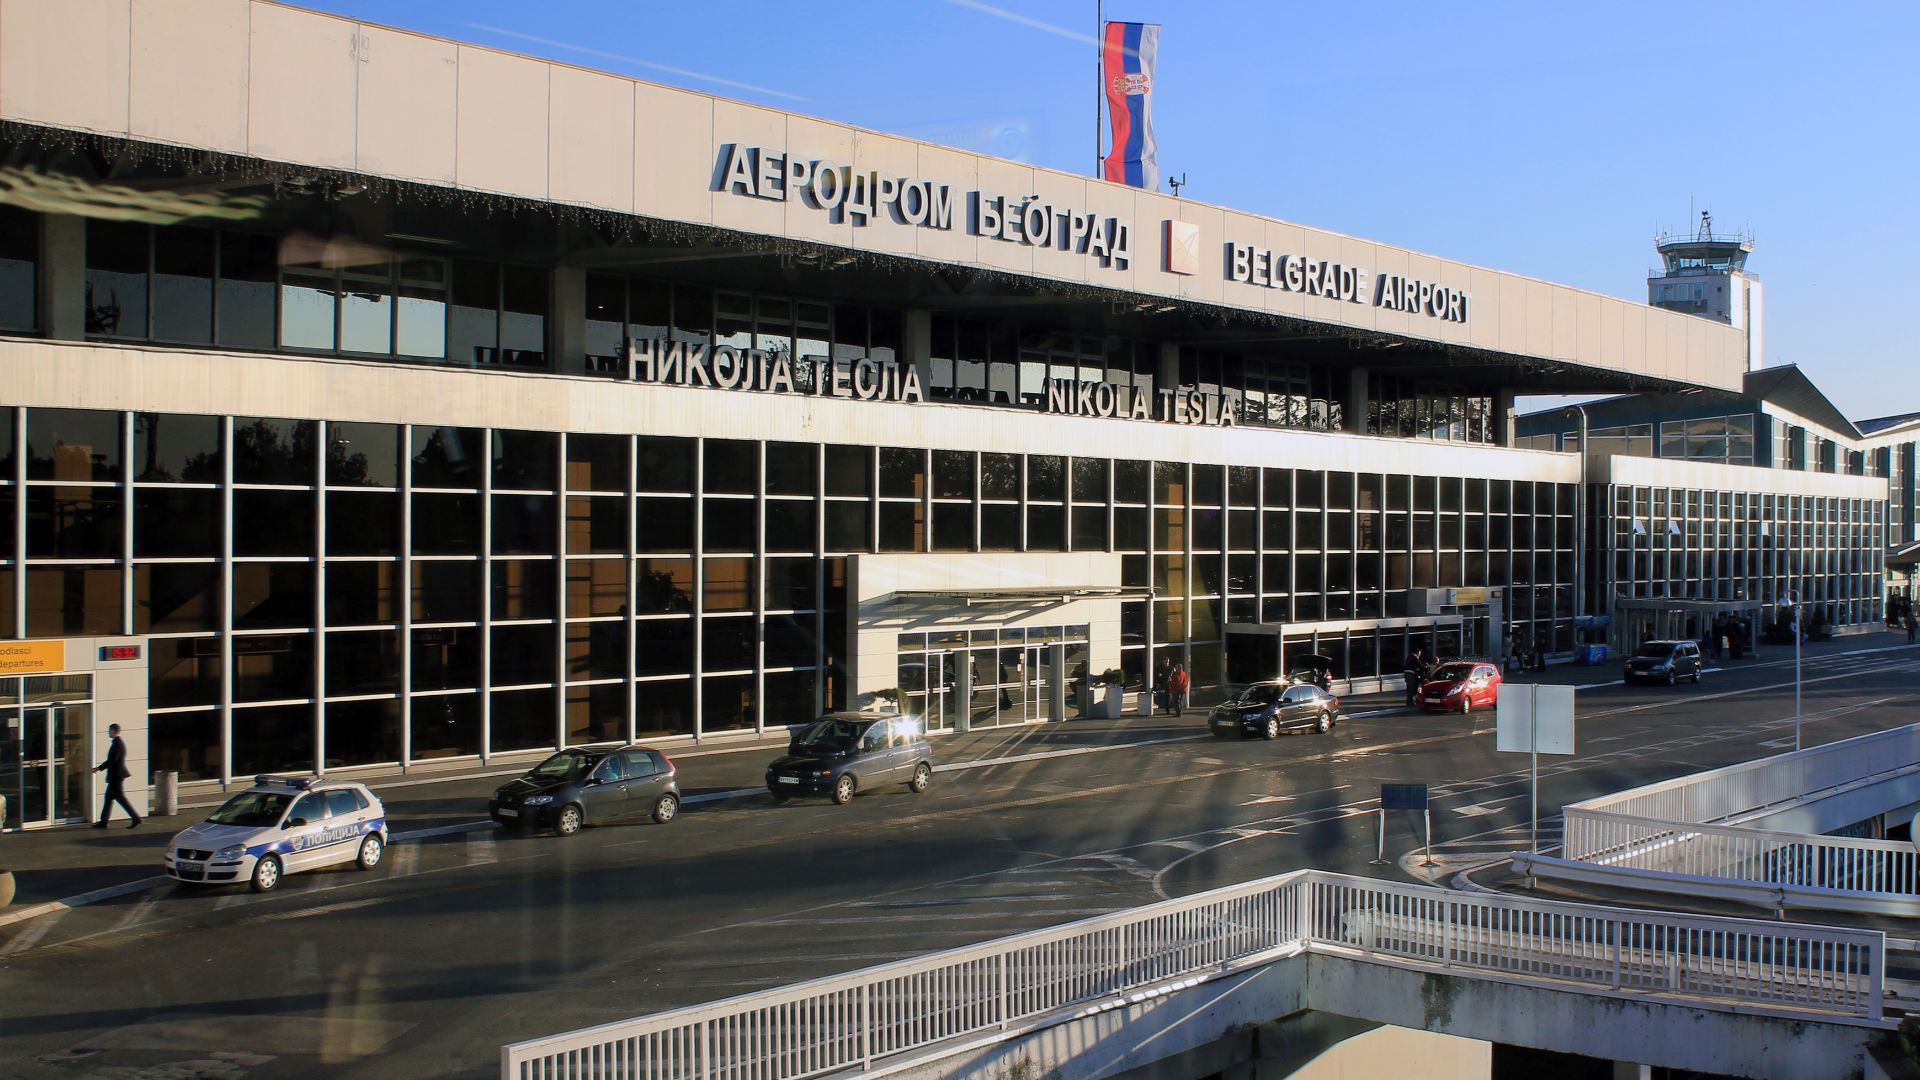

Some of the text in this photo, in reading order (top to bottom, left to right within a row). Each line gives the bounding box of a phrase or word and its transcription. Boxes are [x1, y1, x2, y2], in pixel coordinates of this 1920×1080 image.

[710, 143, 1132, 270] АЕРОДРОМ БЕОГРАД
[1225, 241, 1472, 323] BELGRADE AIRPORT
[627, 337, 924, 403] НИКОЛА ТЕСЛА
[1047, 377, 1236, 427] NIKOLA TESLA
[307, 825, 360, 847] ПОЛИЦИЈА
